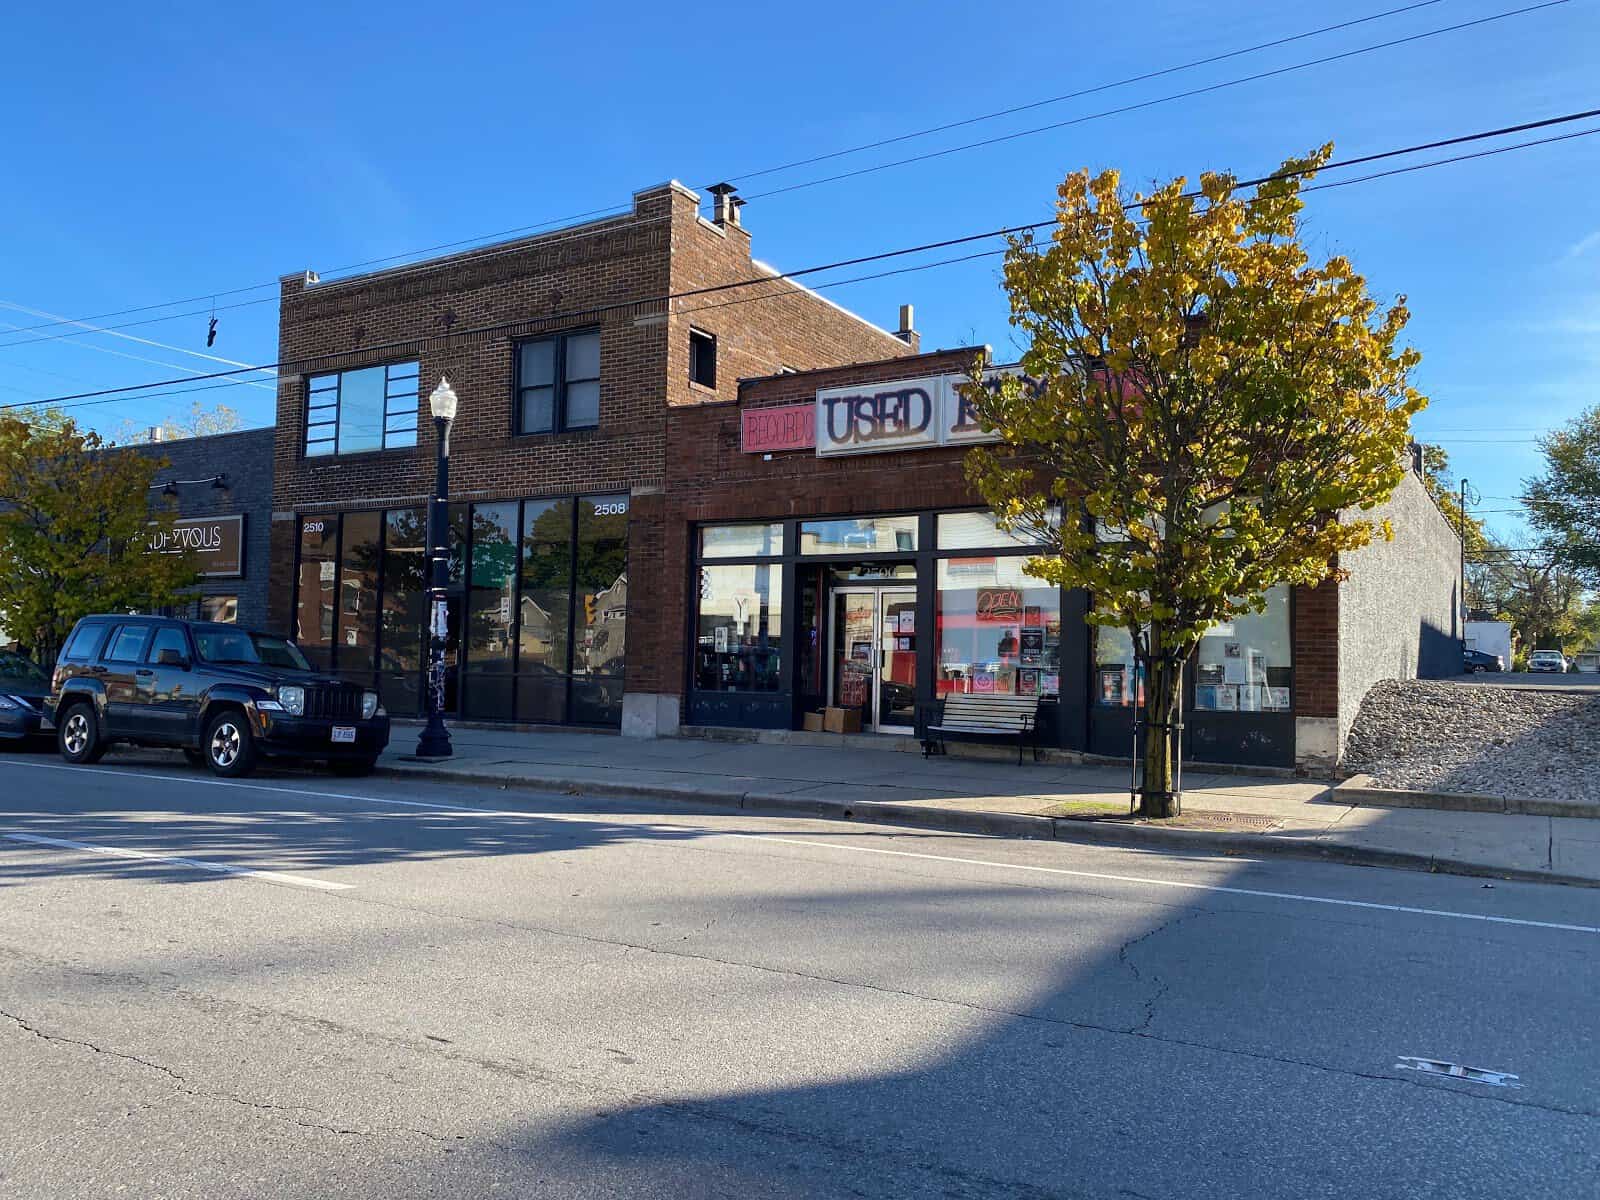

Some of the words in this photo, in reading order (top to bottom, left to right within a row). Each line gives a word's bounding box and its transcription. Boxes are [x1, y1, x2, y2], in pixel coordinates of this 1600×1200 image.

[822, 388, 932, 444] USED
[594, 503, 626, 516] 2508
[303, 521, 324, 533] 2510
[977, 591, 1018, 611] OPEN
